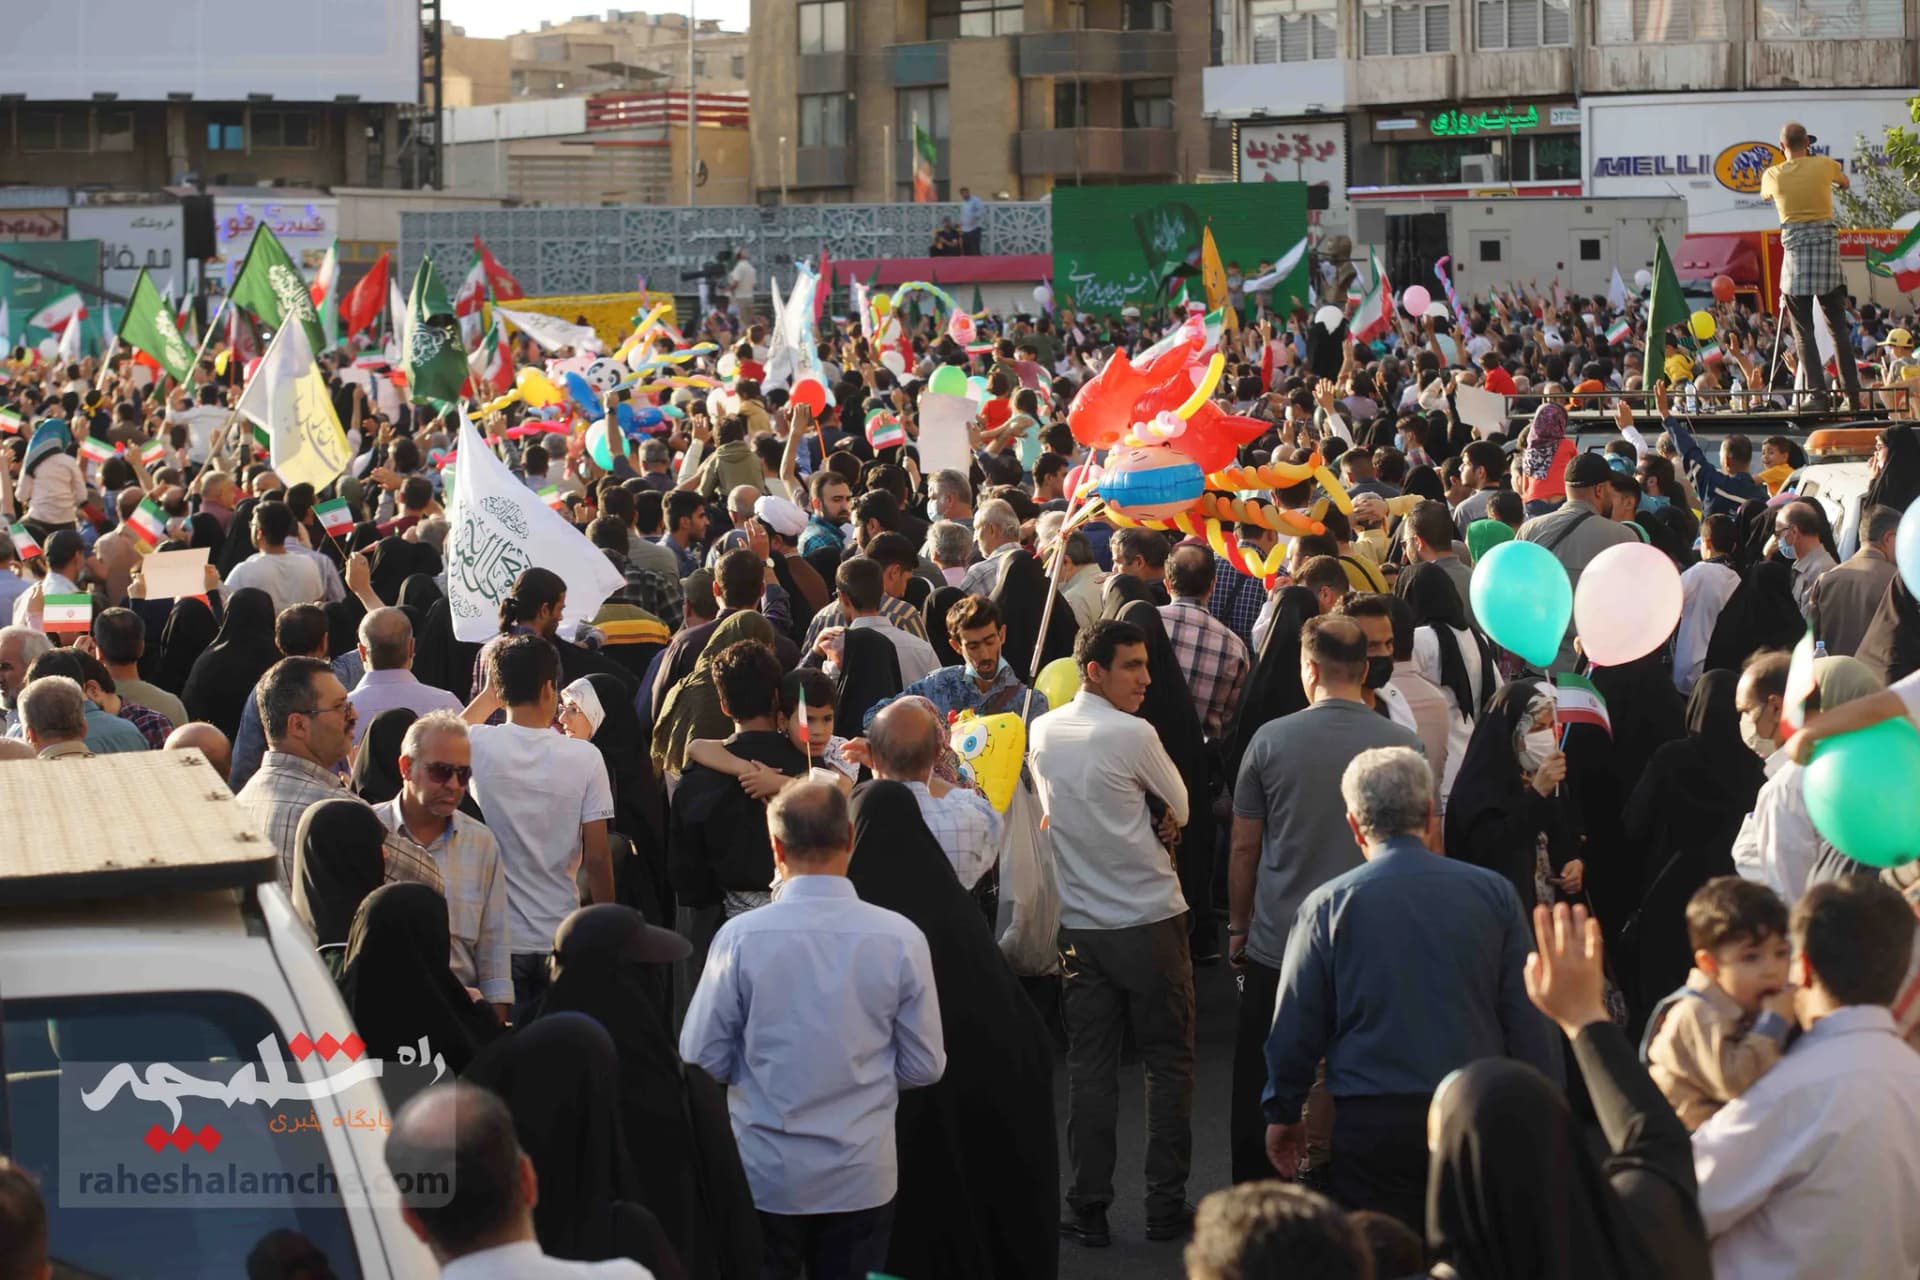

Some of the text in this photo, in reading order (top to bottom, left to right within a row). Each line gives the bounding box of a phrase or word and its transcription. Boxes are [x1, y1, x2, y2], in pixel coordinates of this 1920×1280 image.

[1246, 133, 1336, 168] مرکز خرید
[1593, 154, 1711, 177] MELLI
